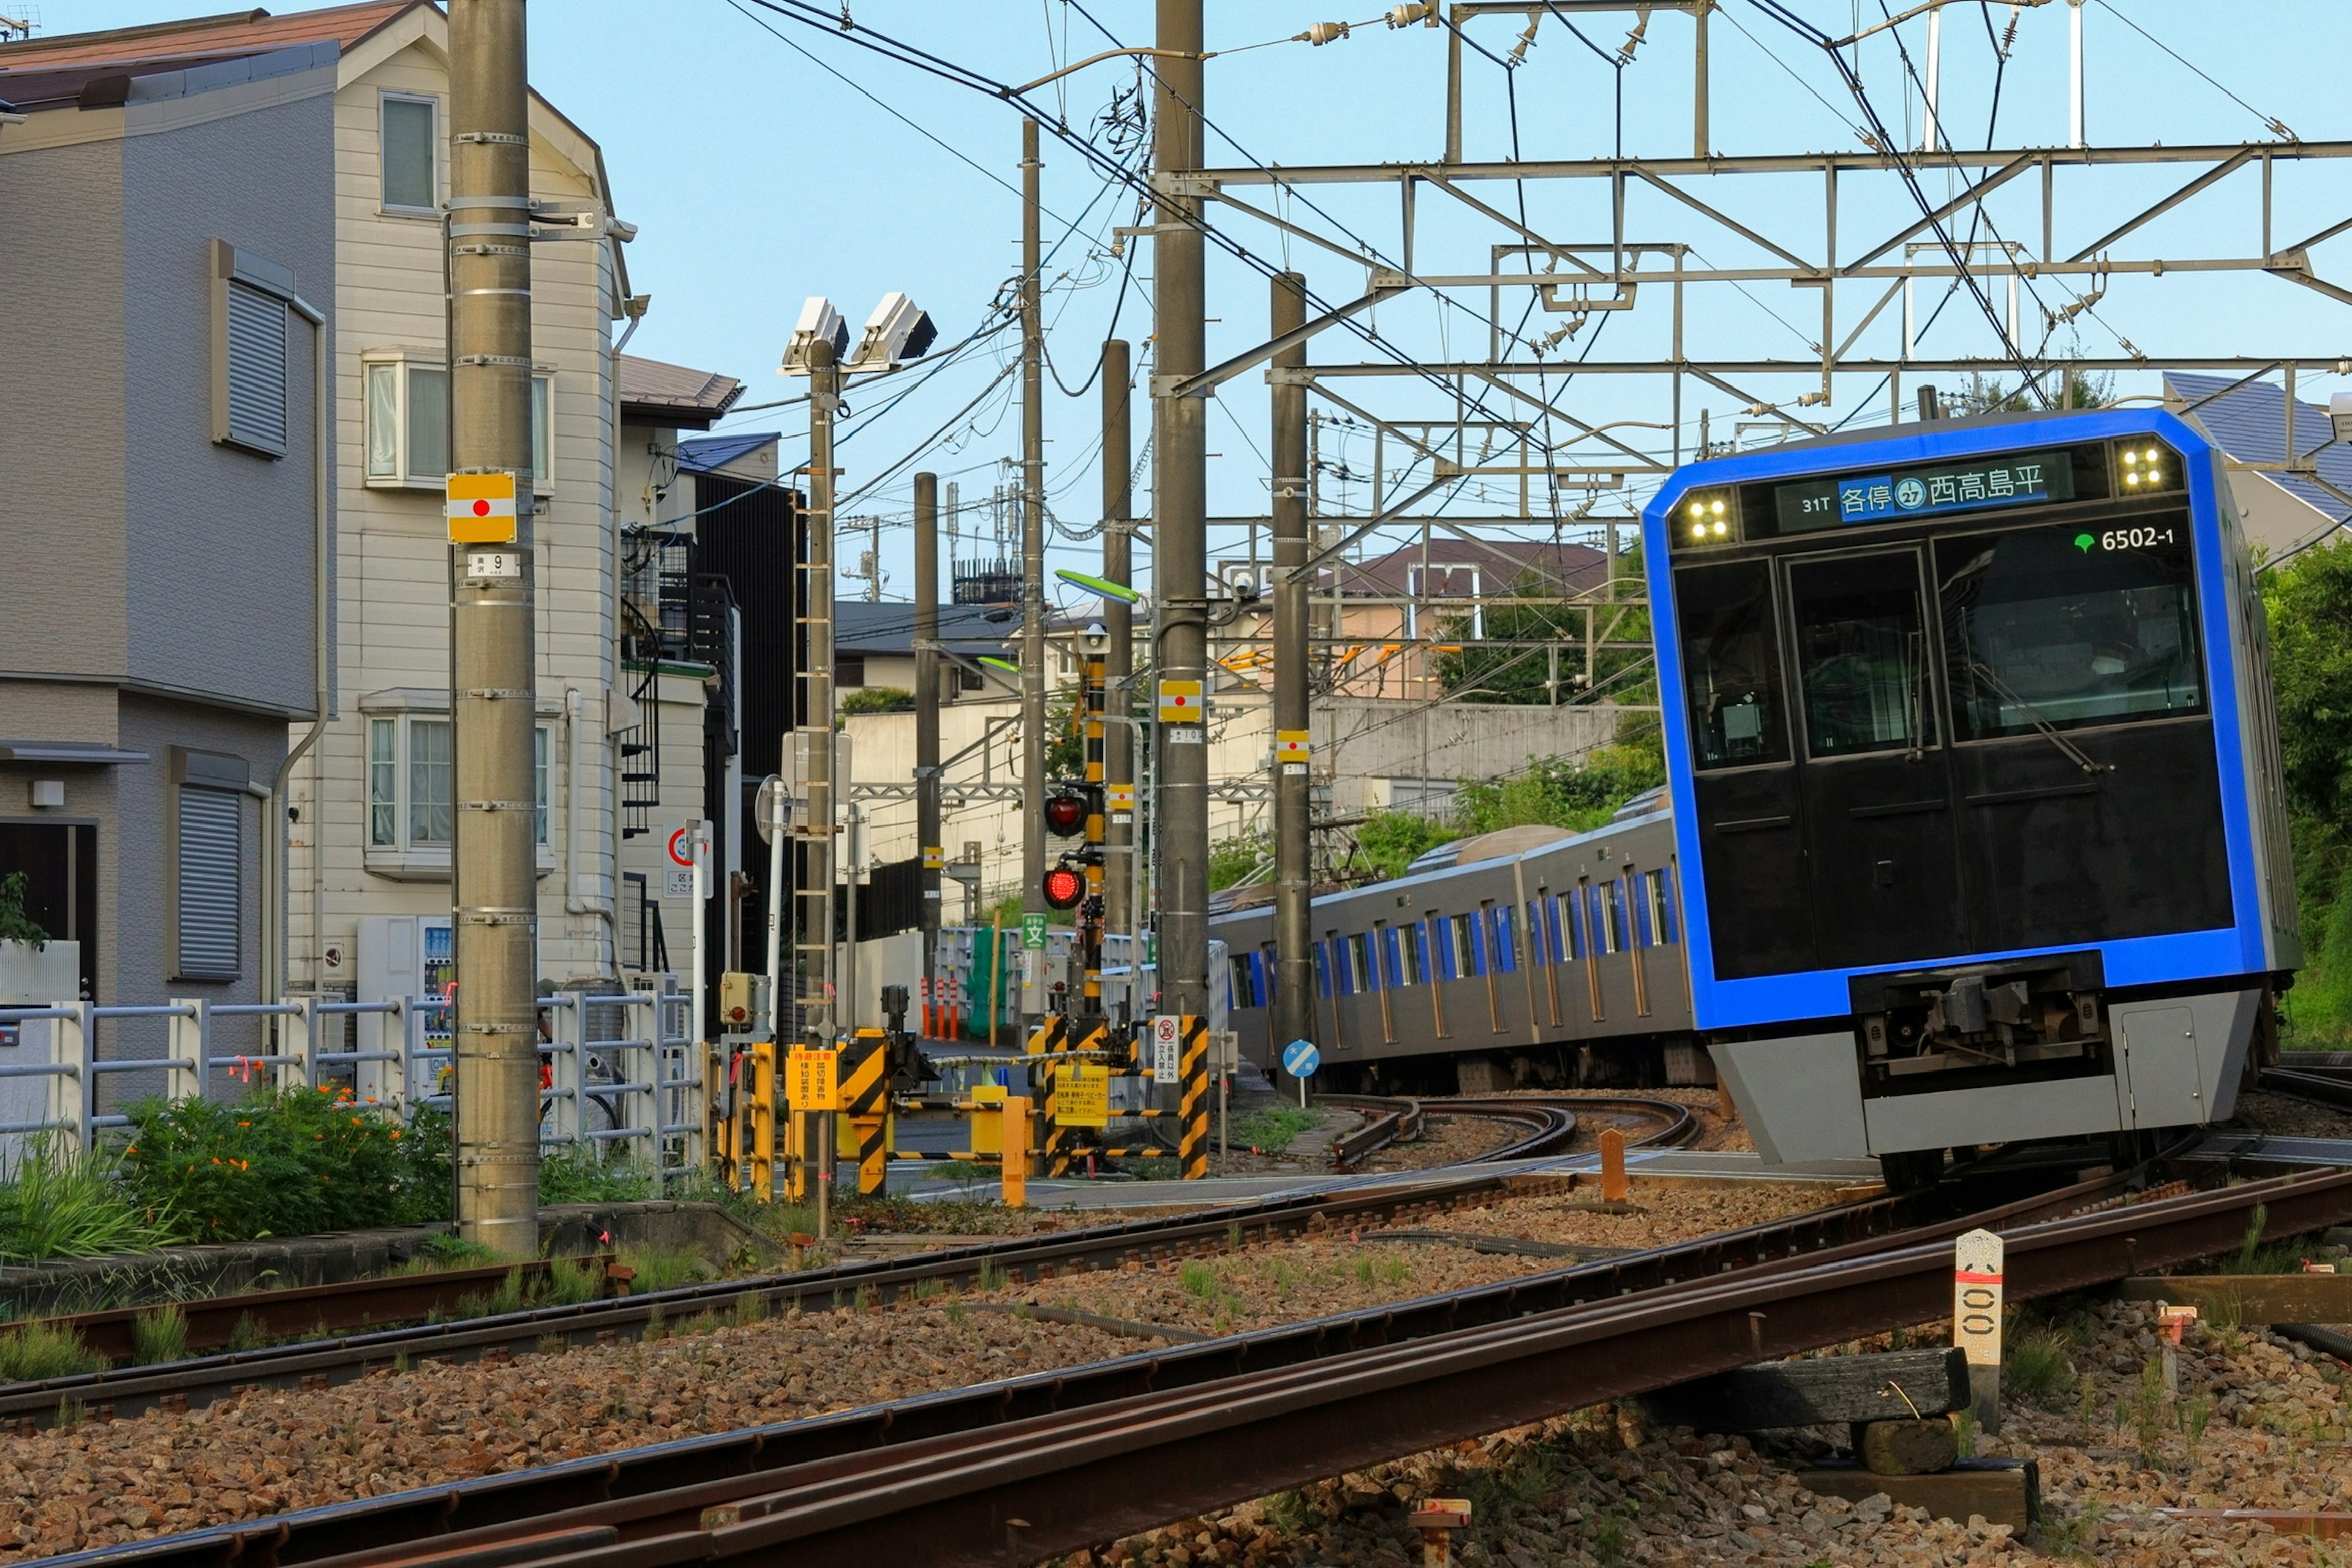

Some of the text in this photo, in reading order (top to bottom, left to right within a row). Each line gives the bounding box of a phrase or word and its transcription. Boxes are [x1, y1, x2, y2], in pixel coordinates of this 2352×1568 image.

[1802, 464, 2044, 514] 31T 各停 西高島平
[1902, 491, 1919, 503] 27
[2102, 527, 2174, 551] 6502-1
[495, 555, 502, 569] 9
[1185, 730, 1196, 739] 10
[1027, 925, 1043, 943] 文
[801, 1062, 809, 1108] 検知装置あり
[816, 1062, 826, 1101] 踏切障害物
